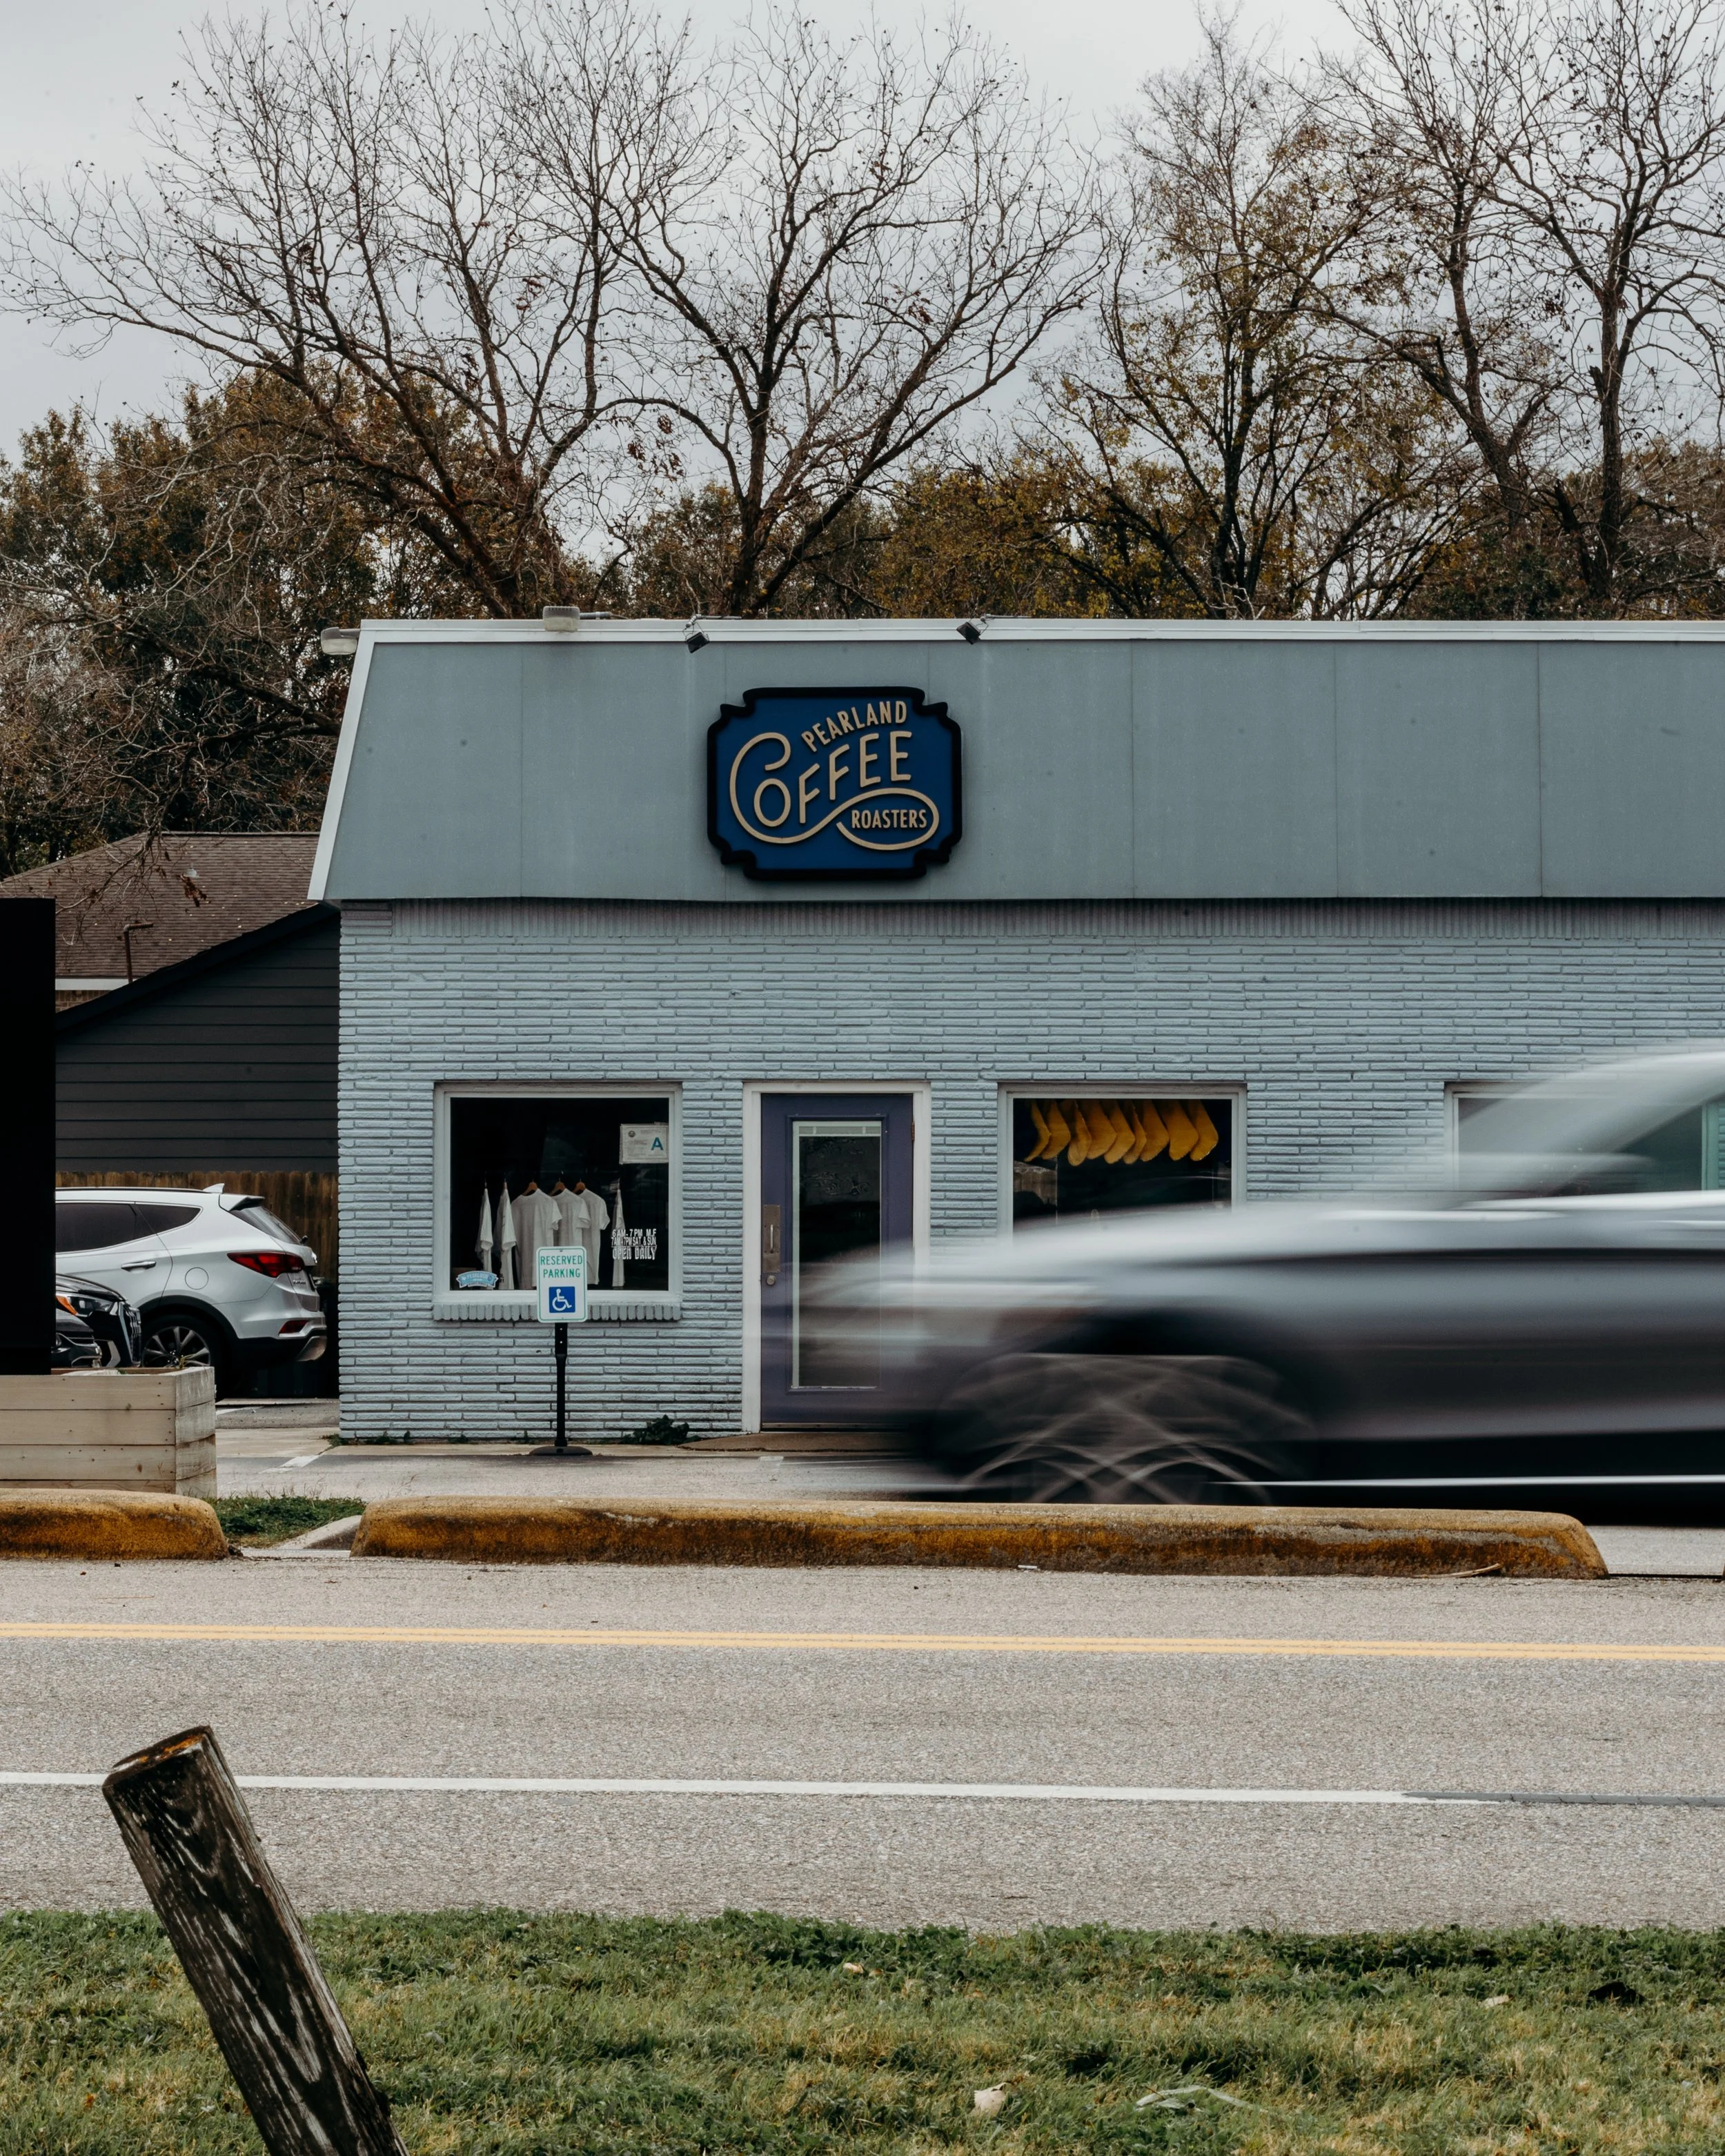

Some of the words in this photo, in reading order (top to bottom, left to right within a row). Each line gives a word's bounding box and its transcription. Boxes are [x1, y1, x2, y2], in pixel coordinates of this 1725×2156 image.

[801, 700, 907, 753] PEARLAND
[730, 731, 913, 844] COFFEE
[851, 809, 927, 829] ROASTERS
[651, 1136, 664, 1151] A
[540, 1255, 583, 1265] RESERVED
[612, 1247, 632, 1260] OPEN
[635, 1246, 657, 1260] DAILY
[543, 1268, 581, 1278] PARKING
